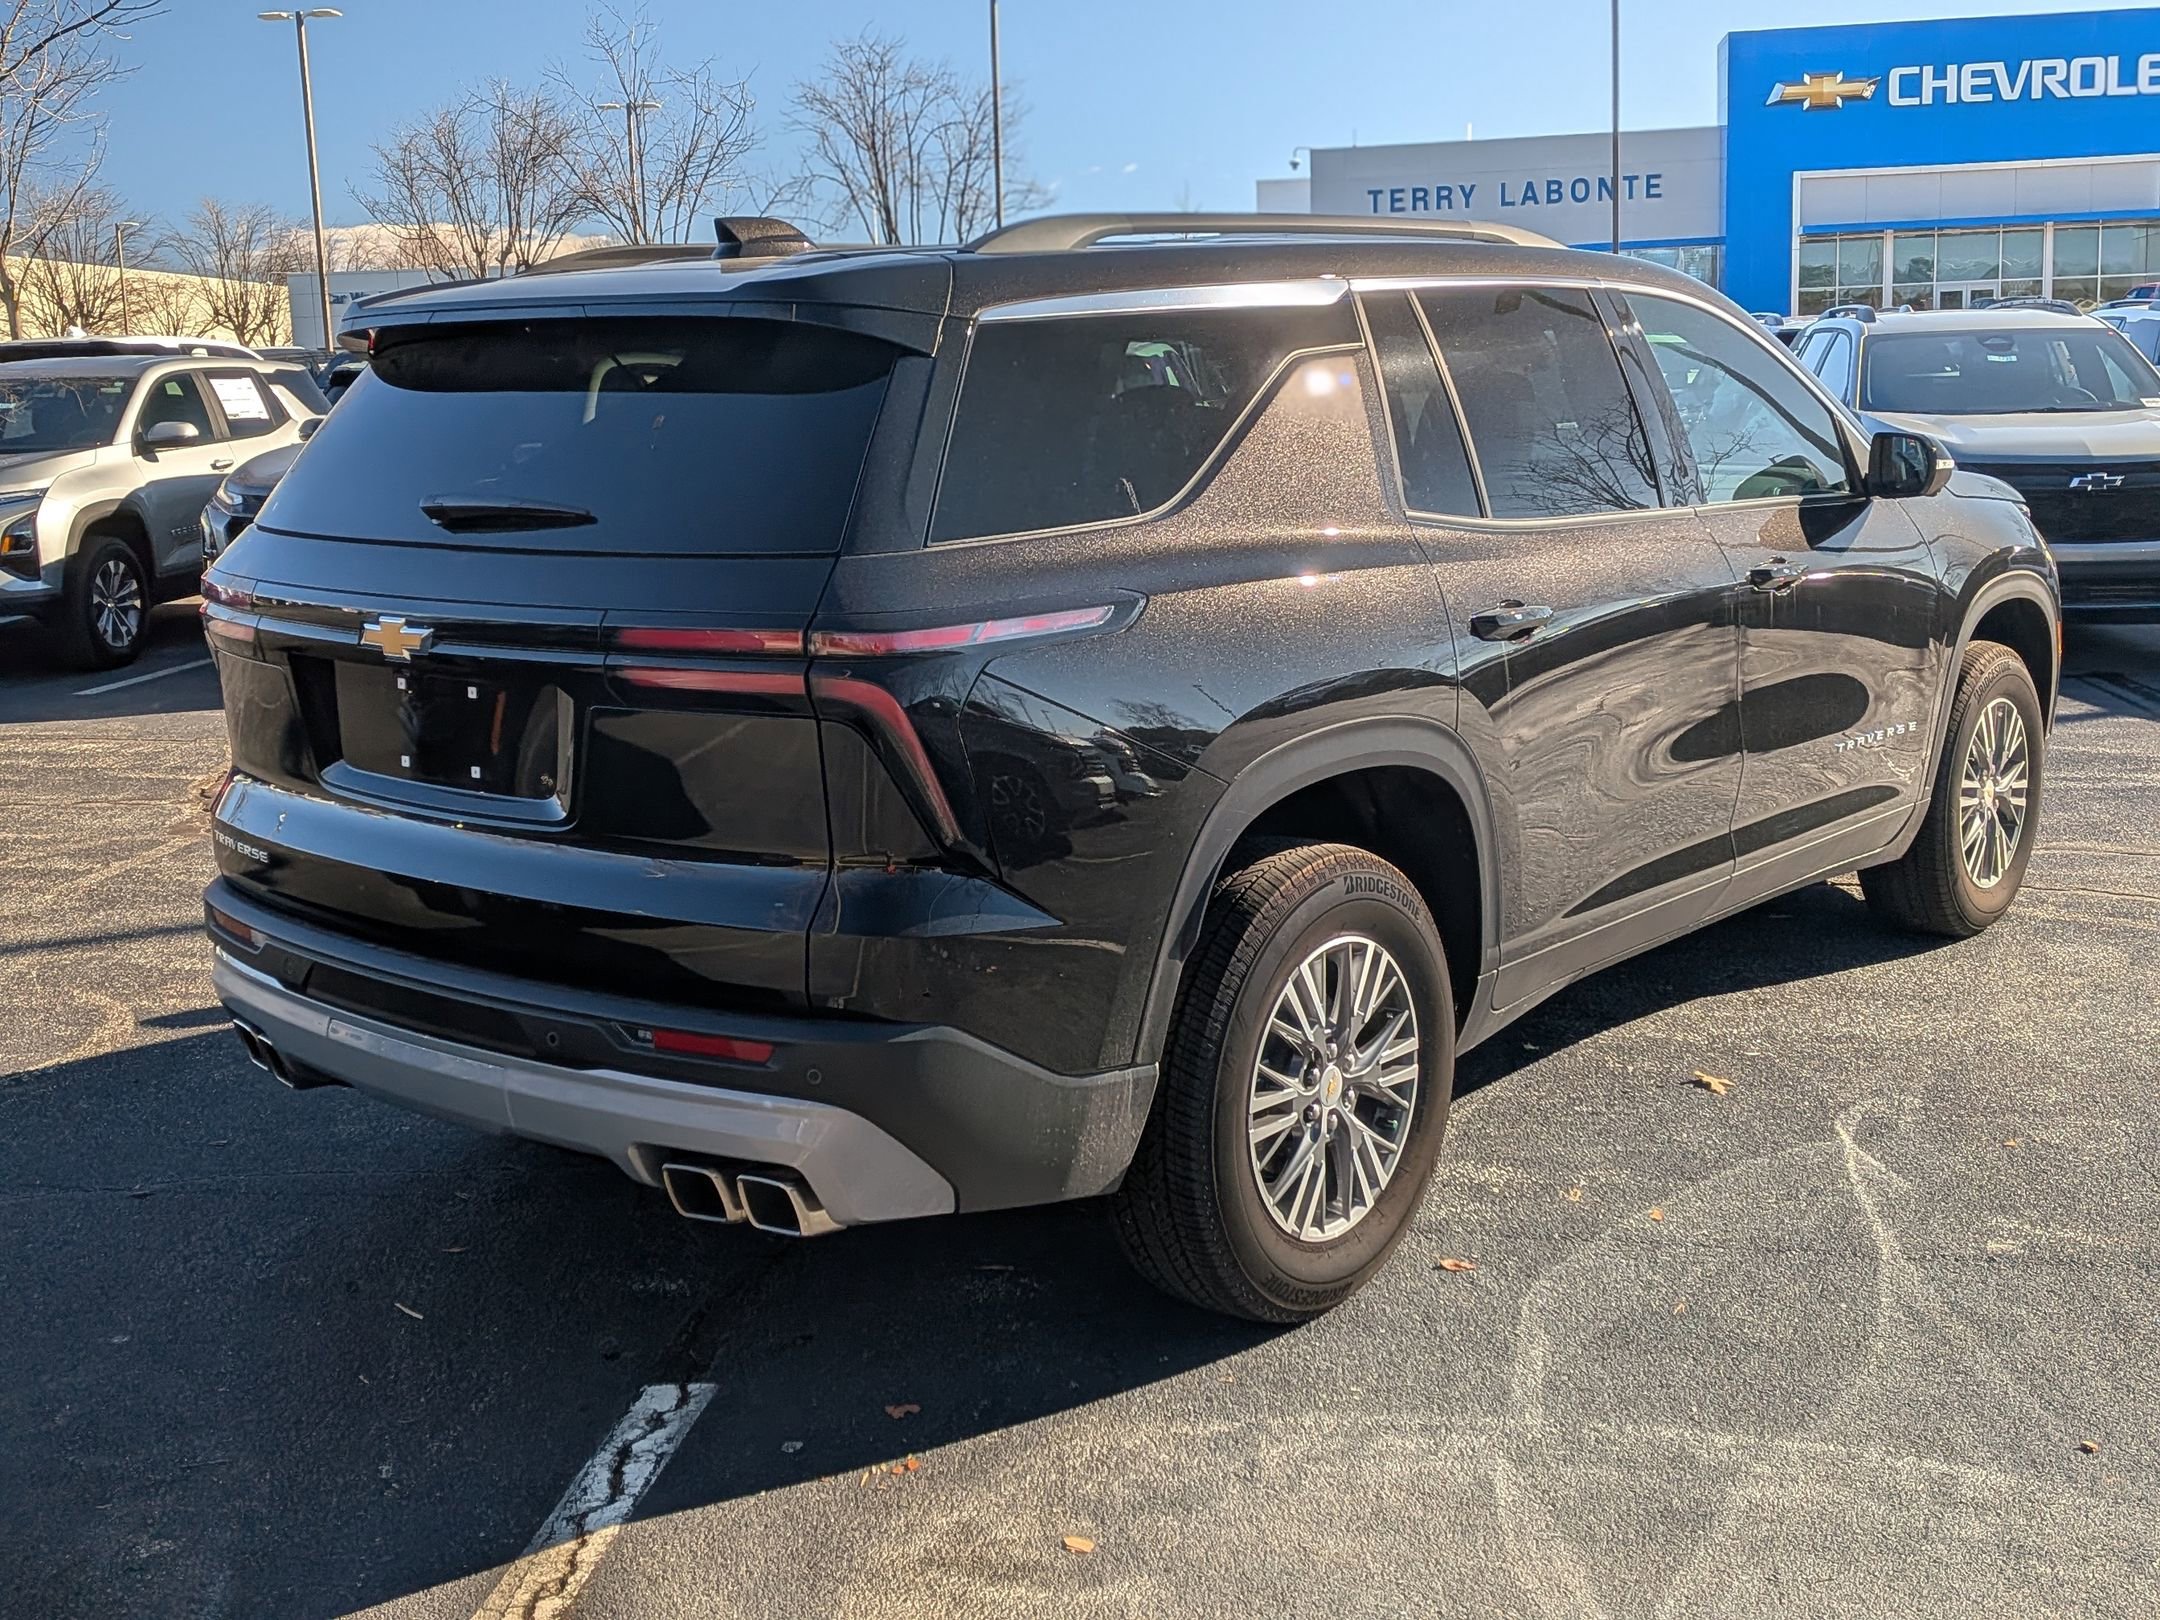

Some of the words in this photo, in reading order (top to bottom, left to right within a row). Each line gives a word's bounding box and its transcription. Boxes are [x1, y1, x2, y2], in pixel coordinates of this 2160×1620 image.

[1367, 184, 1476, 214] TERRY
[1500, 174, 1663, 207] LABONTE
[1834, 721, 1917, 753] TRAVERSE
[214, 829, 269, 863] TRAVERSE
[1343, 875, 1420, 921] BRIDGESTONE
